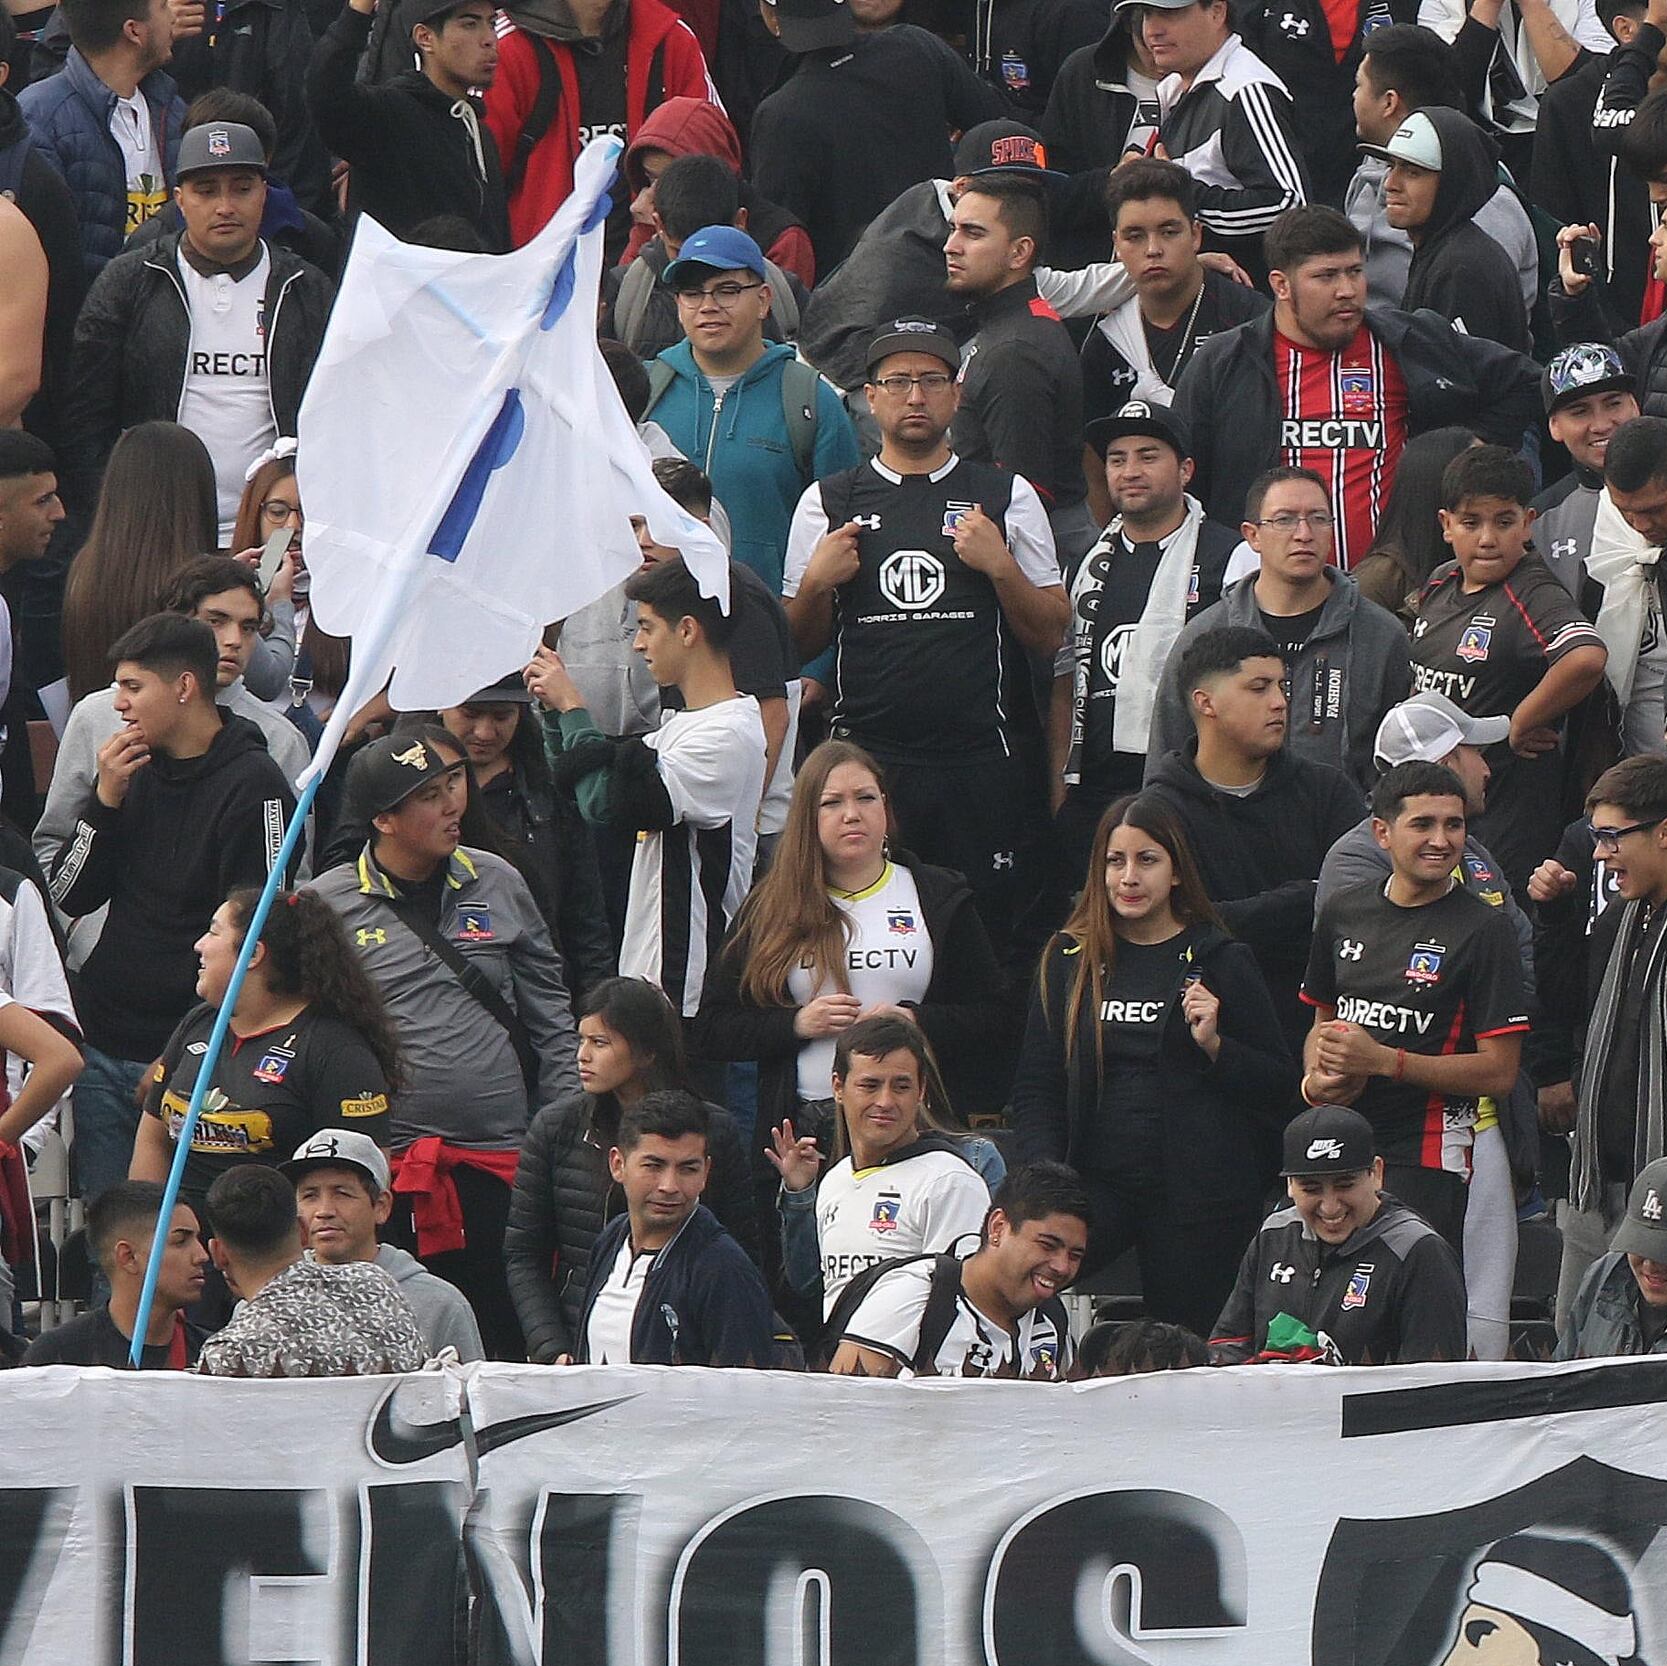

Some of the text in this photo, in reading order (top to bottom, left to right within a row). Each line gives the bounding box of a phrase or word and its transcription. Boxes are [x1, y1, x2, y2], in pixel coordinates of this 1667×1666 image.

[857, 611, 976, 625] MORRIS GARAGES
[1326, 668, 1342, 719] FASHION
[1336, 995, 1435, 1034] DIRECTV
